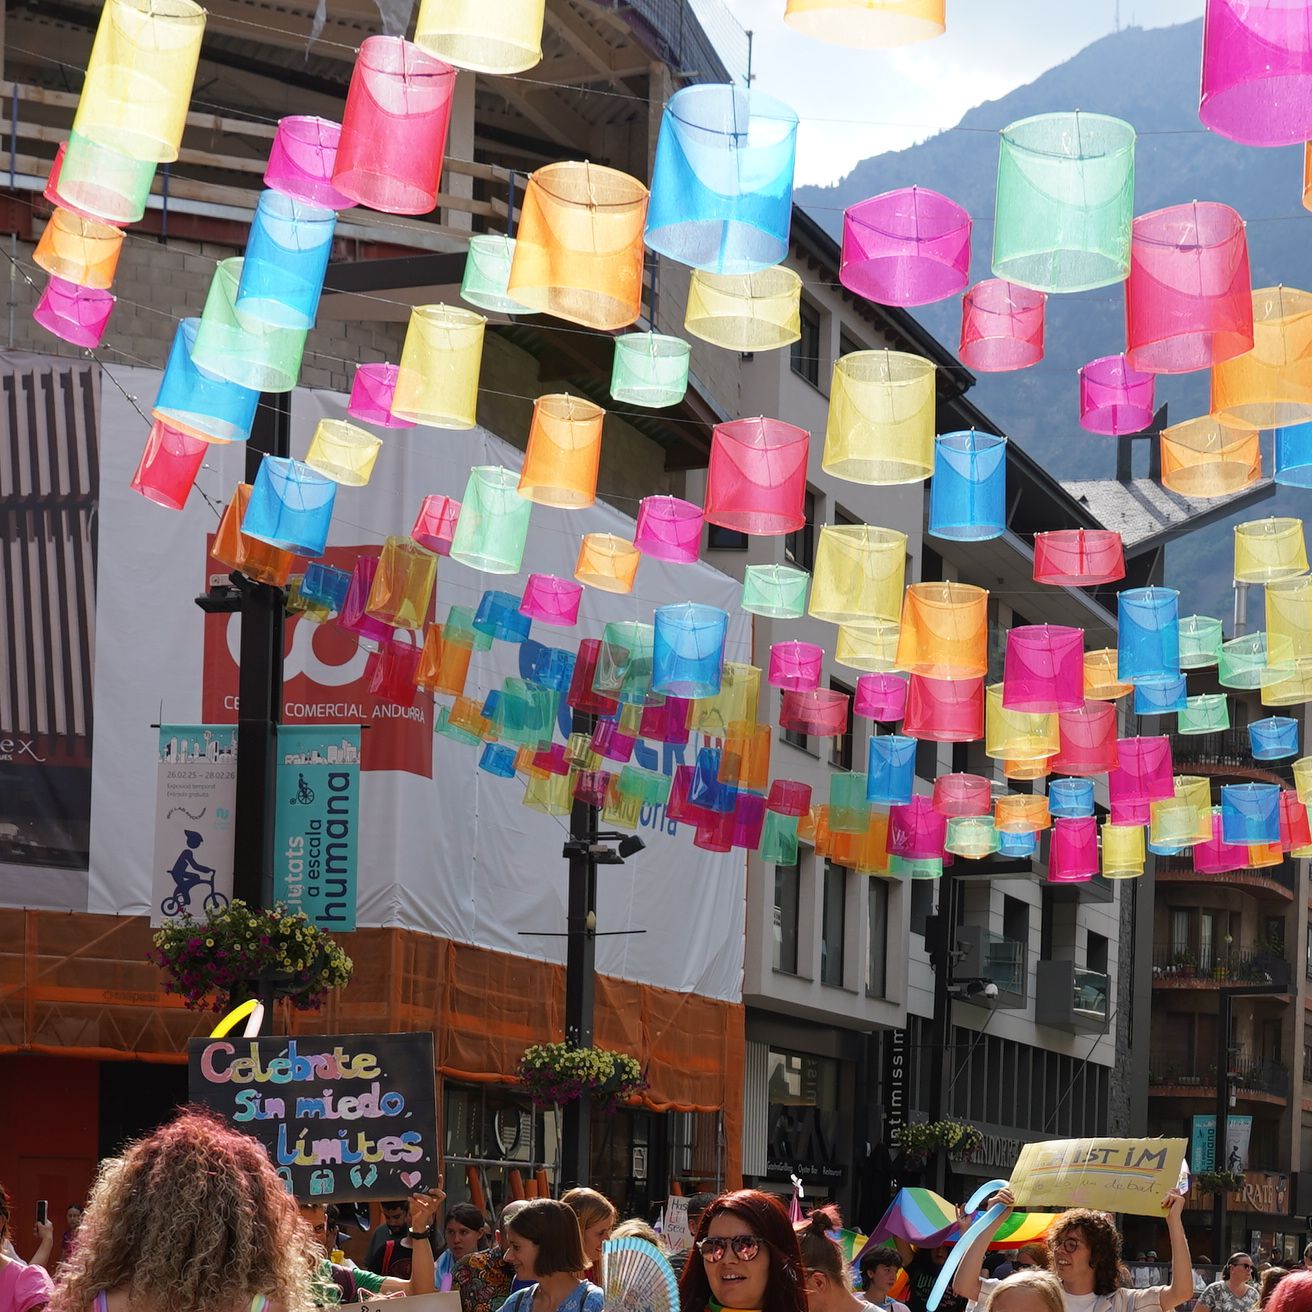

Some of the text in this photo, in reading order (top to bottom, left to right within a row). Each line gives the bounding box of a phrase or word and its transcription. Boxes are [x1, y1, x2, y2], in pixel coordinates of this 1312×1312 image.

[285, 702, 367, 718] COMERCIAL
[286, 836, 305, 912] iutats
[305, 819, 322, 897] a escala
[315, 772, 350, 921] humana
[233, 1089, 286, 1121] Sin
